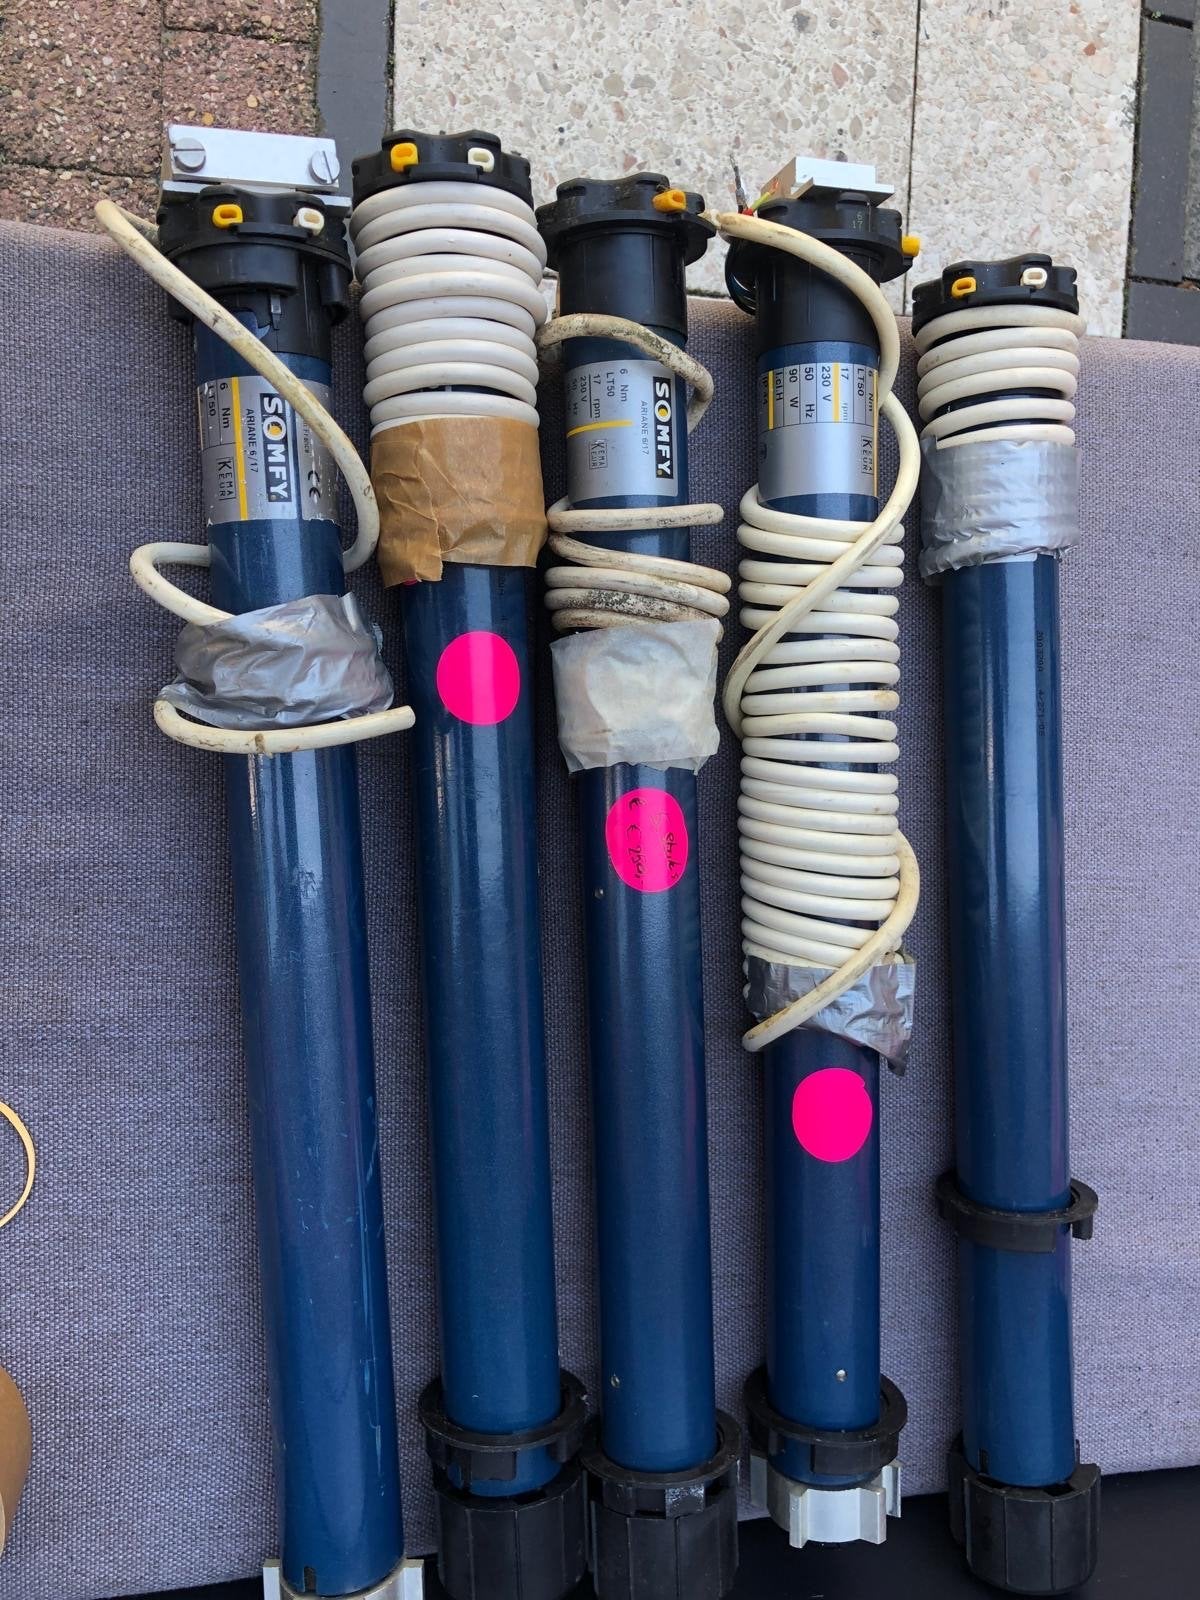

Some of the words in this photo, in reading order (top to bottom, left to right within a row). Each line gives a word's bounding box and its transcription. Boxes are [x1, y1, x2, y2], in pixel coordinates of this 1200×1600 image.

[593, 373, 601, 385] 17
[606, 371, 616, 397] LT50
[788, 368, 798, 383] 90
[804, 366, 814, 381] 50
[821, 365, 832, 387] 230
[840, 368, 849, 380] 17
[857, 368, 865, 396] LT50
[219, 382, 229, 391] 6
[620, 384, 629, 402] Nm
[207, 385, 216, 417] LT50
[592, 398, 601, 419] rpm
[789, 396, 799, 408] W
[822, 394, 832, 402] V
[221, 407, 231, 429] Nm
[640, 400, 649, 436] ARIANE
[805, 403, 815, 419] Hz
[246, 408, 257, 447] ARIANE
[654, 382, 671, 475] SOMFY
[262, 396, 288, 499] SOMFY
[641, 438, 650, 455] 6/17
[248, 450, 259, 473] 6/17
